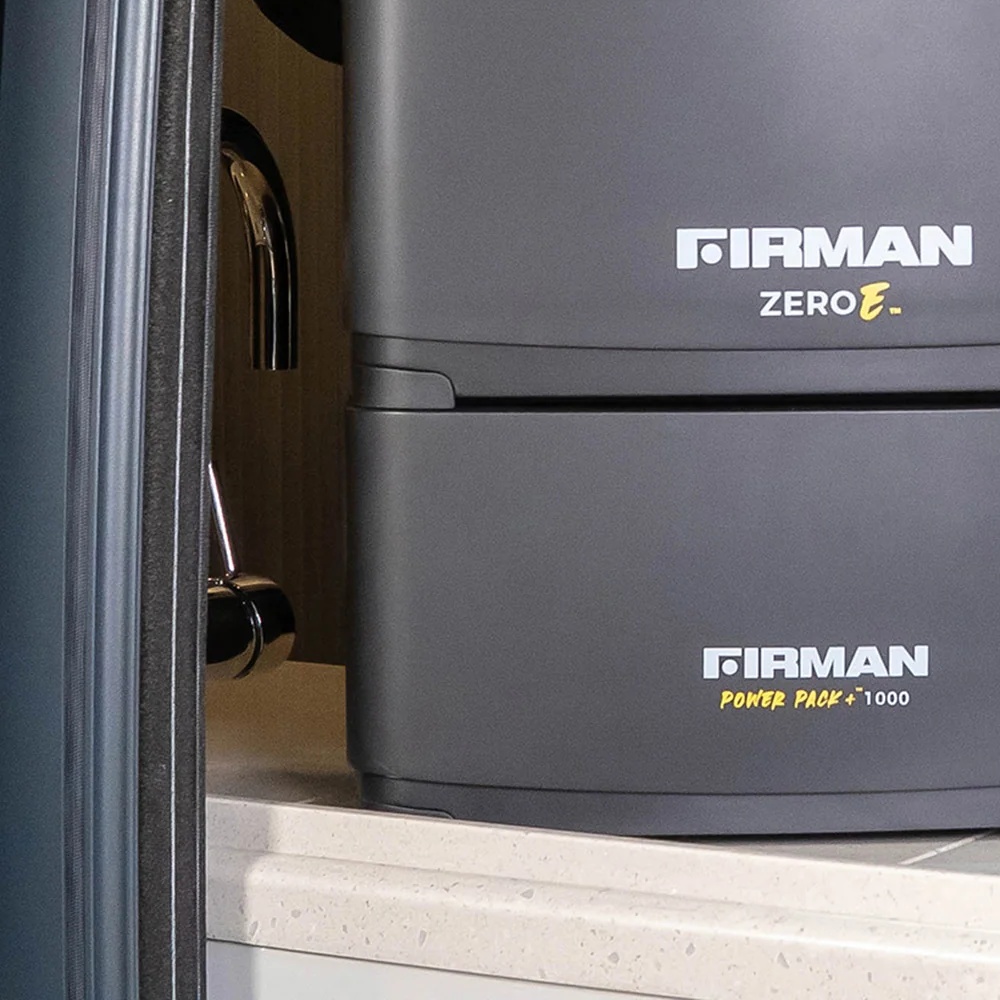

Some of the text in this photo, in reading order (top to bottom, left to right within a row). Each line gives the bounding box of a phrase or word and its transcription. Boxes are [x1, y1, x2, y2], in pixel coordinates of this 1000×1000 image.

[675, 224, 974, 270] FIRMAN
[703, 645, 929, 679] FIRMAN
[719, 688, 786, 710] POWER
[864, 690, 910, 706] 1000
